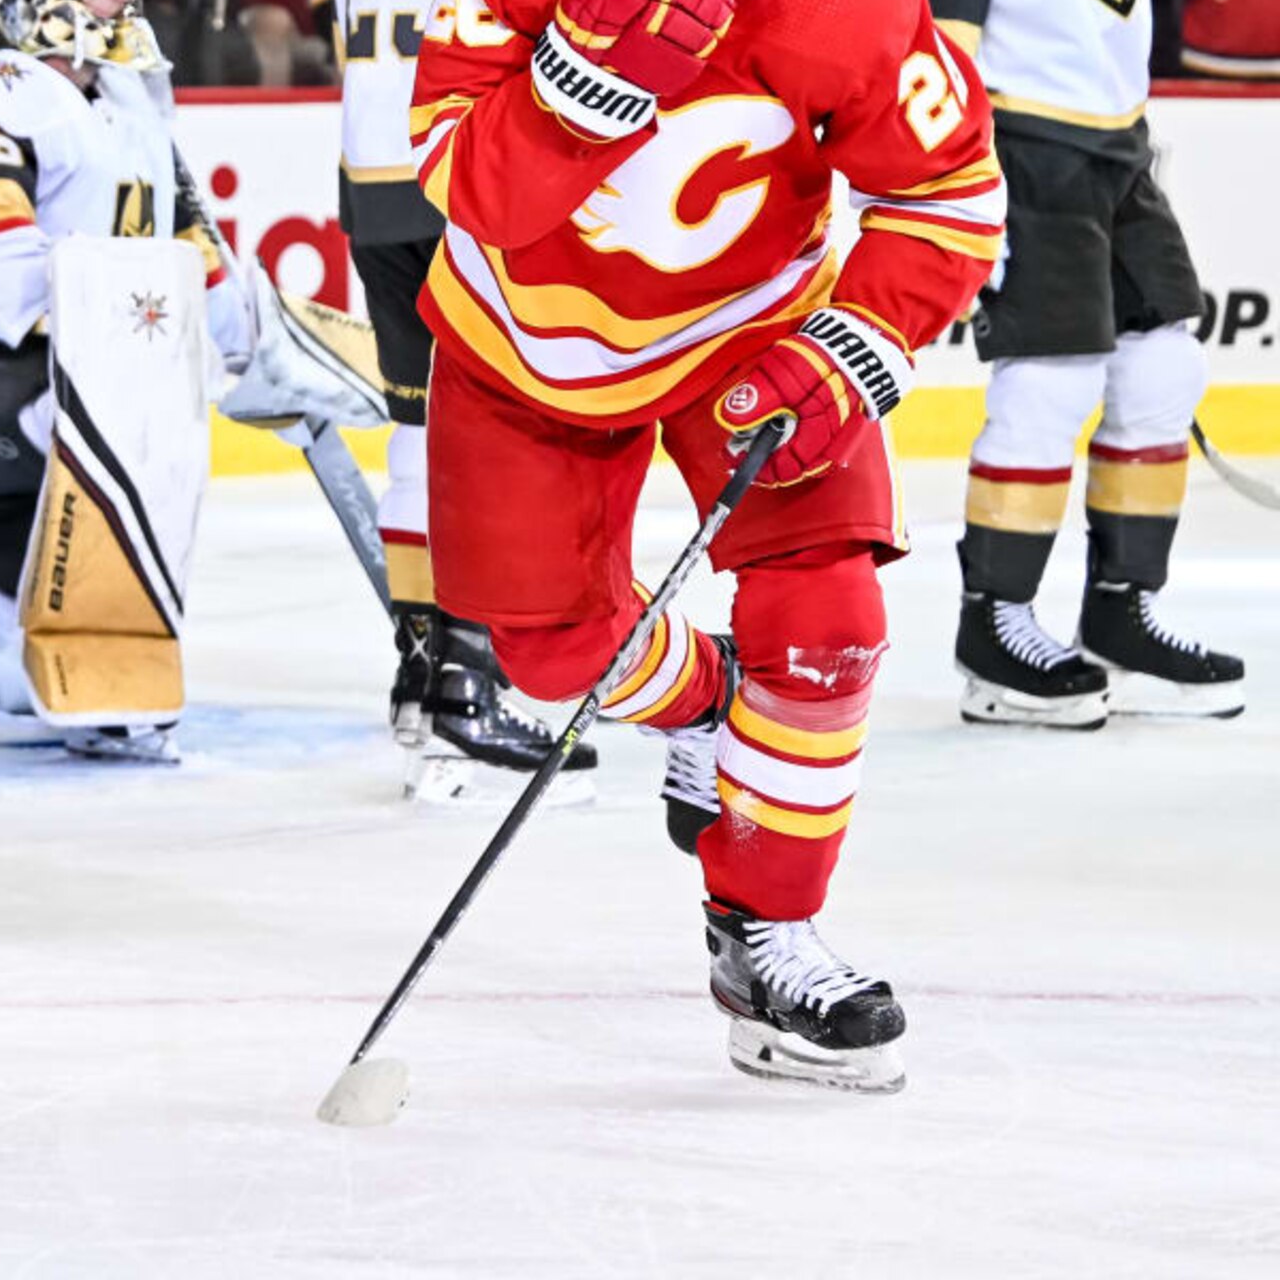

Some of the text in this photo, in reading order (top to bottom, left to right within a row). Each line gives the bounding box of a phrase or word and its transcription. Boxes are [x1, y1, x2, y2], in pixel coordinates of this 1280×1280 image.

[898, 49, 969, 154] 2
[800, 311, 901, 418] WARRI
[48, 491, 77, 613] BAUER
